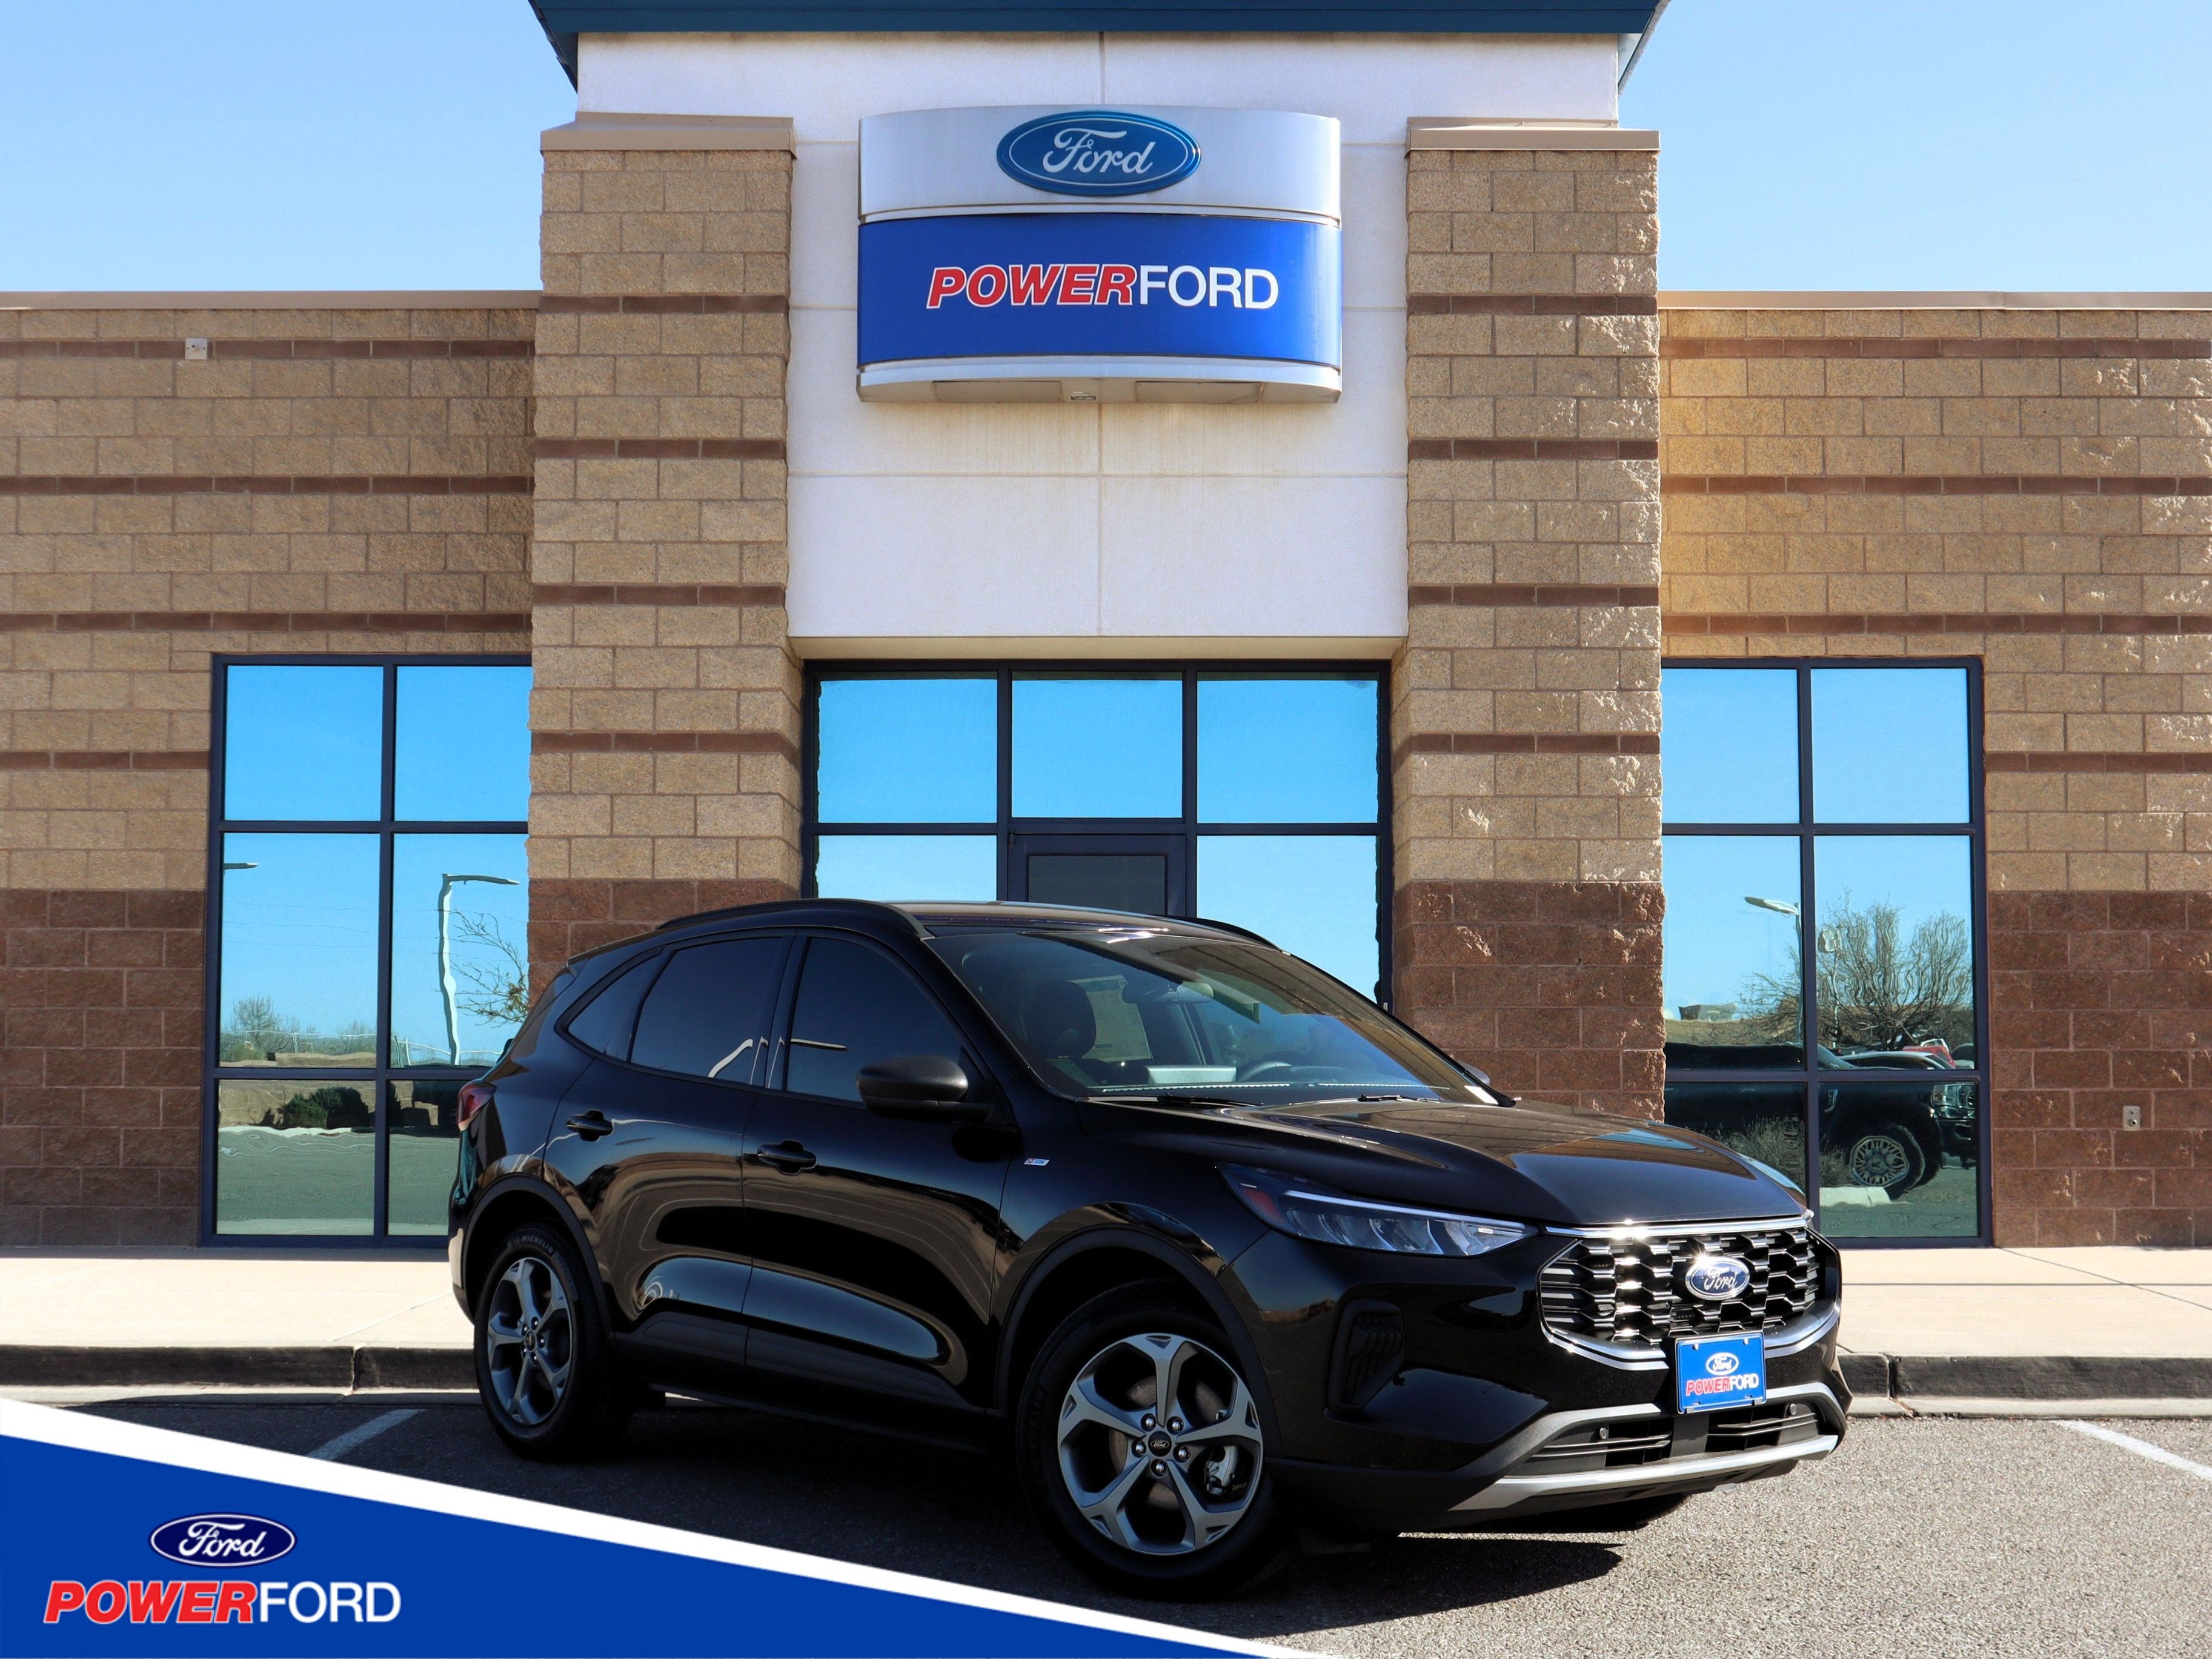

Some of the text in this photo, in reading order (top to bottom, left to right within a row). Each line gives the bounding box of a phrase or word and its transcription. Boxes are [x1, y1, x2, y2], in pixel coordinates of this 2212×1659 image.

[1043, 127, 1156, 175] Ford
[926, 264, 1280, 310] POWERFORD
[522, 1235, 554, 1254] MICHELIN
[1704, 1266, 1738, 1291] Ford
[1712, 1357, 1733, 1371] Ford
[1686, 1373, 1759, 1395] POWERFORD
